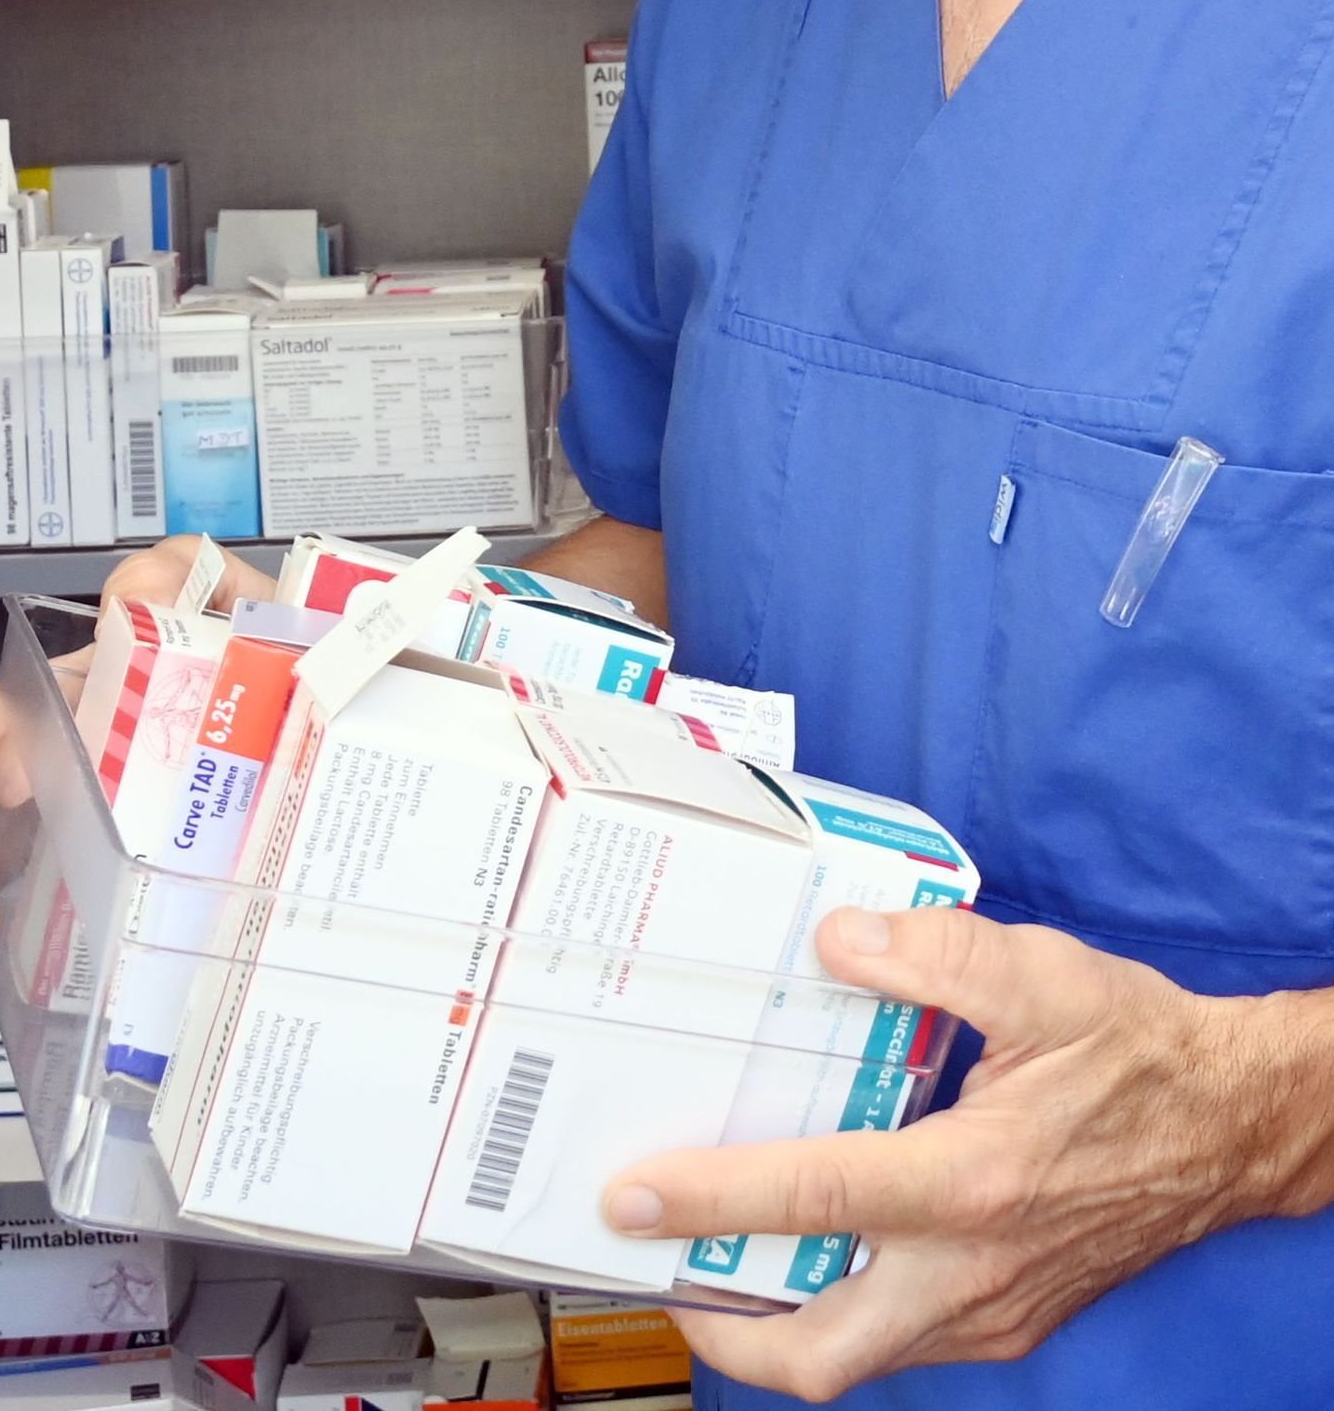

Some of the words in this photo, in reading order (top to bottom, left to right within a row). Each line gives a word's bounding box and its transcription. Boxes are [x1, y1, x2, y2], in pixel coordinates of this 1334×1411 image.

[4, 425, 17, 520] magensaftresistente
[496, 627, 510, 649] 100
[206, 699, 236, 743] 6,25
[226, 681, 246, 703] mg
[342, 747, 365, 795] Enthält
[361, 763, 375, 785] mg
[371, 751, 381, 759] 8
[381, 755, 397, 788] Jede
[399, 759, 413, 787] zum
[211, 766, 238, 818] Tabletten
[235, 769, 257, 812] Carvedilol
[305, 743, 349, 859] Packungsbeilage
[408, 765, 433, 816] Tablette
[500, 781, 513, 797] 98
[174, 800, 205, 849] Carve
[363, 795, 388, 846] Tablette
[375, 792, 407, 869] Einnehmen
[481, 803, 507, 863] Tabletten
[319, 789, 371, 932] Candesartancileetil.
[347, 851, 367, 898] enthält
[474, 868, 487, 886] N3
[584, 819, 624, 919] Retardtablette
[615, 827, 641, 881] D-89150
[653, 835, 673, 878] ALIUD
[813, 865, 827, 887] 100
[285, 864, 311, 927] beacten.
[590, 885, 621, 956] Laichinge
[598, 827, 657, 993] Gottlieb-Daimler-raße
[779, 891, 818, 983] Retardtablett
[592, 995, 604, 1007] 19
[773, 991, 785, 1008] N3
[232, 1011, 265, 1103] unzugänglich
[253, 1013, 285, 1097] Arzneimittel
[260, 1018, 303, 1133] Packungsbeilage
[429, 1032, 461, 1104] Tabletten
[246, 1102, 260, 1121] für
[260, 1018, 321, 1183] Verschreibungspflichtig
[202, 1107, 237, 1200] aufbewahren.
[231, 1125, 253, 1170] Kinder
[241, 1138, 267, 1200] beachten.
[807, 1254, 830, 1283] mg
